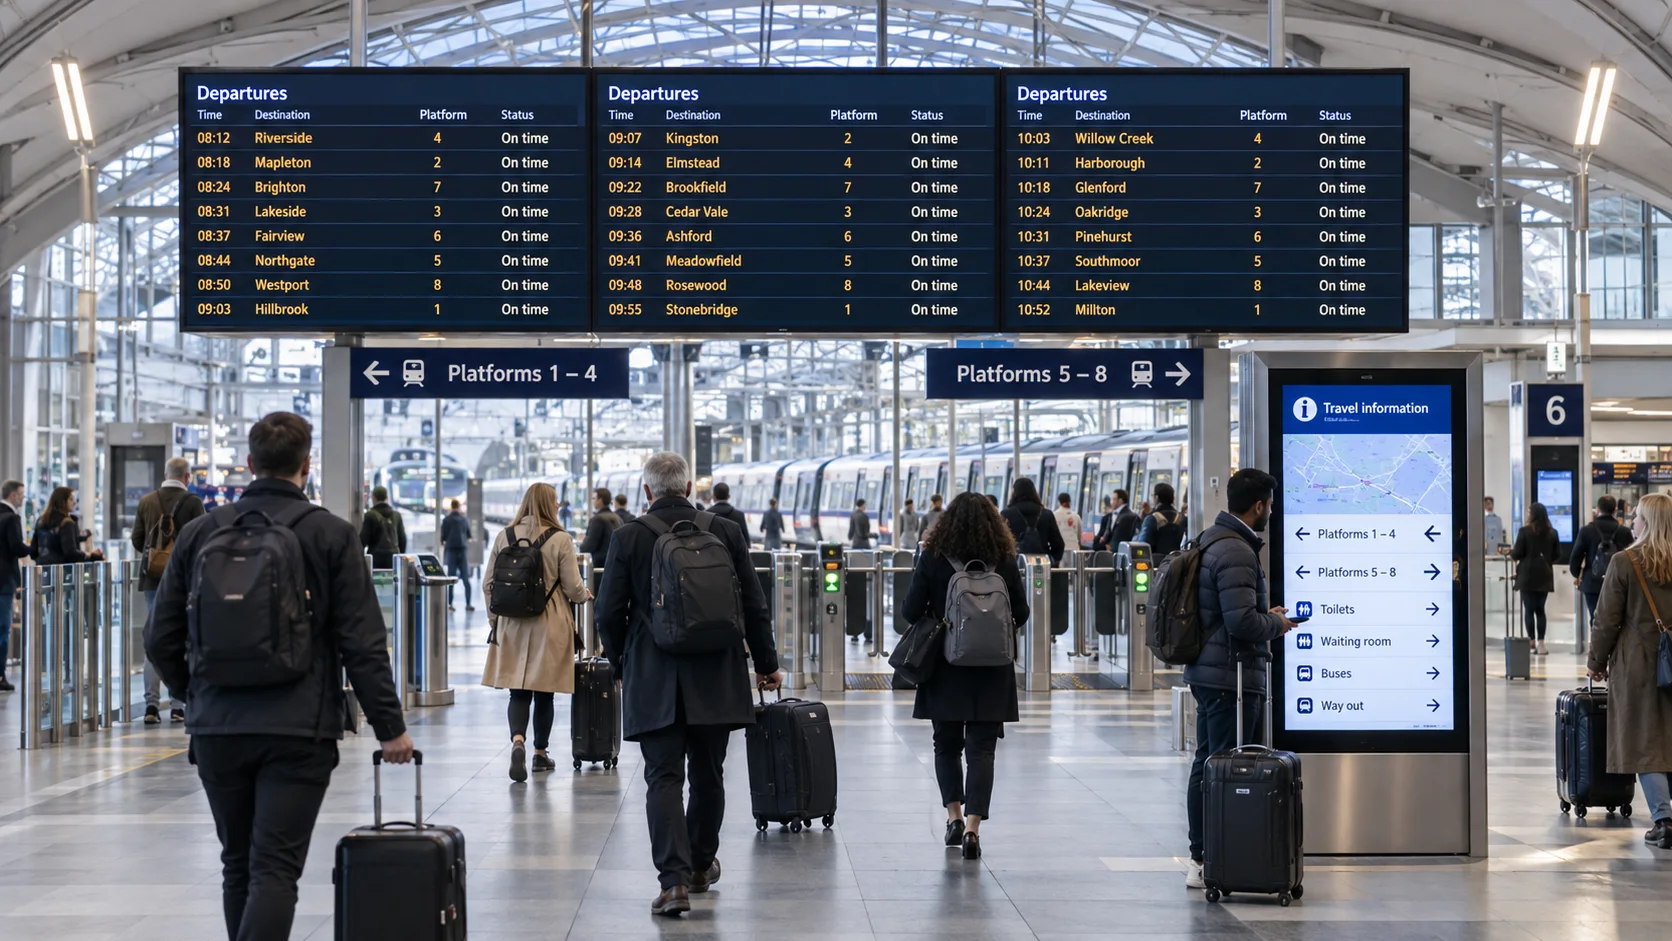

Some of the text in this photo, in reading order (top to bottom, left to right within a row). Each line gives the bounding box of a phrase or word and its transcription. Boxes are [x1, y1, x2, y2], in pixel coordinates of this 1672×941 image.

[197, 85, 288, 105] Departures
[608, 85, 699, 105] Departures
[1017, 85, 1108, 105] Departures
[197, 108, 535, 120] Time Destination Platform Status
[608, 108, 944, 121] Time Destination Platform Status
[1017, 109, 1352, 121] Time Destination Platform Status
[197, 131, 549, 144] 08:12 Riverside 4 On time
[608, 132, 959, 147] 09:07 Kingston 2 On time
[1017, 132, 1367, 145] 10:03 Willow Creek 4 On time
[197, 155, 549, 171] 08:18 Mapleton 2 On time
[608, 156, 959, 169] 09:14 Elmstead 4 On time
[1017, 156, 1262, 172] 10:11 Harborough 2
[197, 180, 550, 196] 08:24 Brighton 7 On time
[608, 180, 852, 194] 09:22 Brookfield 7
[1018, 180, 1367, 194] 10:18 Glenford 7 On time
[197, 205, 441, 218] 08:31 Lakeside 3
[608, 205, 959, 218] 09:28 Cedar Vale 3 On time
[1018, 205, 1367, 221] 10:24 Oakridge 3 On time
[197, 229, 550, 242] 08:37 Fairview 6 On time
[608, 229, 959, 243] 09:36 Ashford 6 On time
[1017, 230, 1262, 243] 10:31 Pinehurst 6
[197, 254, 549, 269] 08:44 Northgate 5 On time
[608, 254, 852, 267] 09:41 Meadowfield 5
[1018, 254, 1366, 268] 10:37 Southmoor 5 On time
[197, 278, 442, 294] 08:50 Westport 8
[608, 278, 959, 292] 09:48 Rosewood 8 On time
[1017, 278, 1367, 292] 10:44 Lakeview 8 On time
[197, 302, 549, 316] 09:03 Hillbrook 1 On time
[608, 303, 959, 318] 09:55 Stonebridge 1 On time
[1017, 303, 1367, 316] 10:52 Millton 1 On time
[448, 363, 542, 382] Platforms
[549, 364, 558, 382] 1
[584, 364, 598, 382] 4
[957, 364, 1051, 383] Platforms
[1059, 365, 1071, 383] 5
[1095, 365, 1107, 383] 8
[1322, 401, 1429, 414] Travel information
[1546, 395, 1566, 426] 6
[1318, 528, 1369, 540] Platforms
[1371, 529, 1377, 539] 1
[1388, 528, 1397, 539] 4
[1318, 566, 1369, 578] Platforms
[1371, 567, 1378, 578] 5
[1389, 567, 1397, 578] 8
[1320, 604, 1355, 615] Toilets
[1320, 636, 1392, 649] Waiting room
[1321, 668, 1352, 679] Buses
[1321, 700, 1364, 713] Way out
